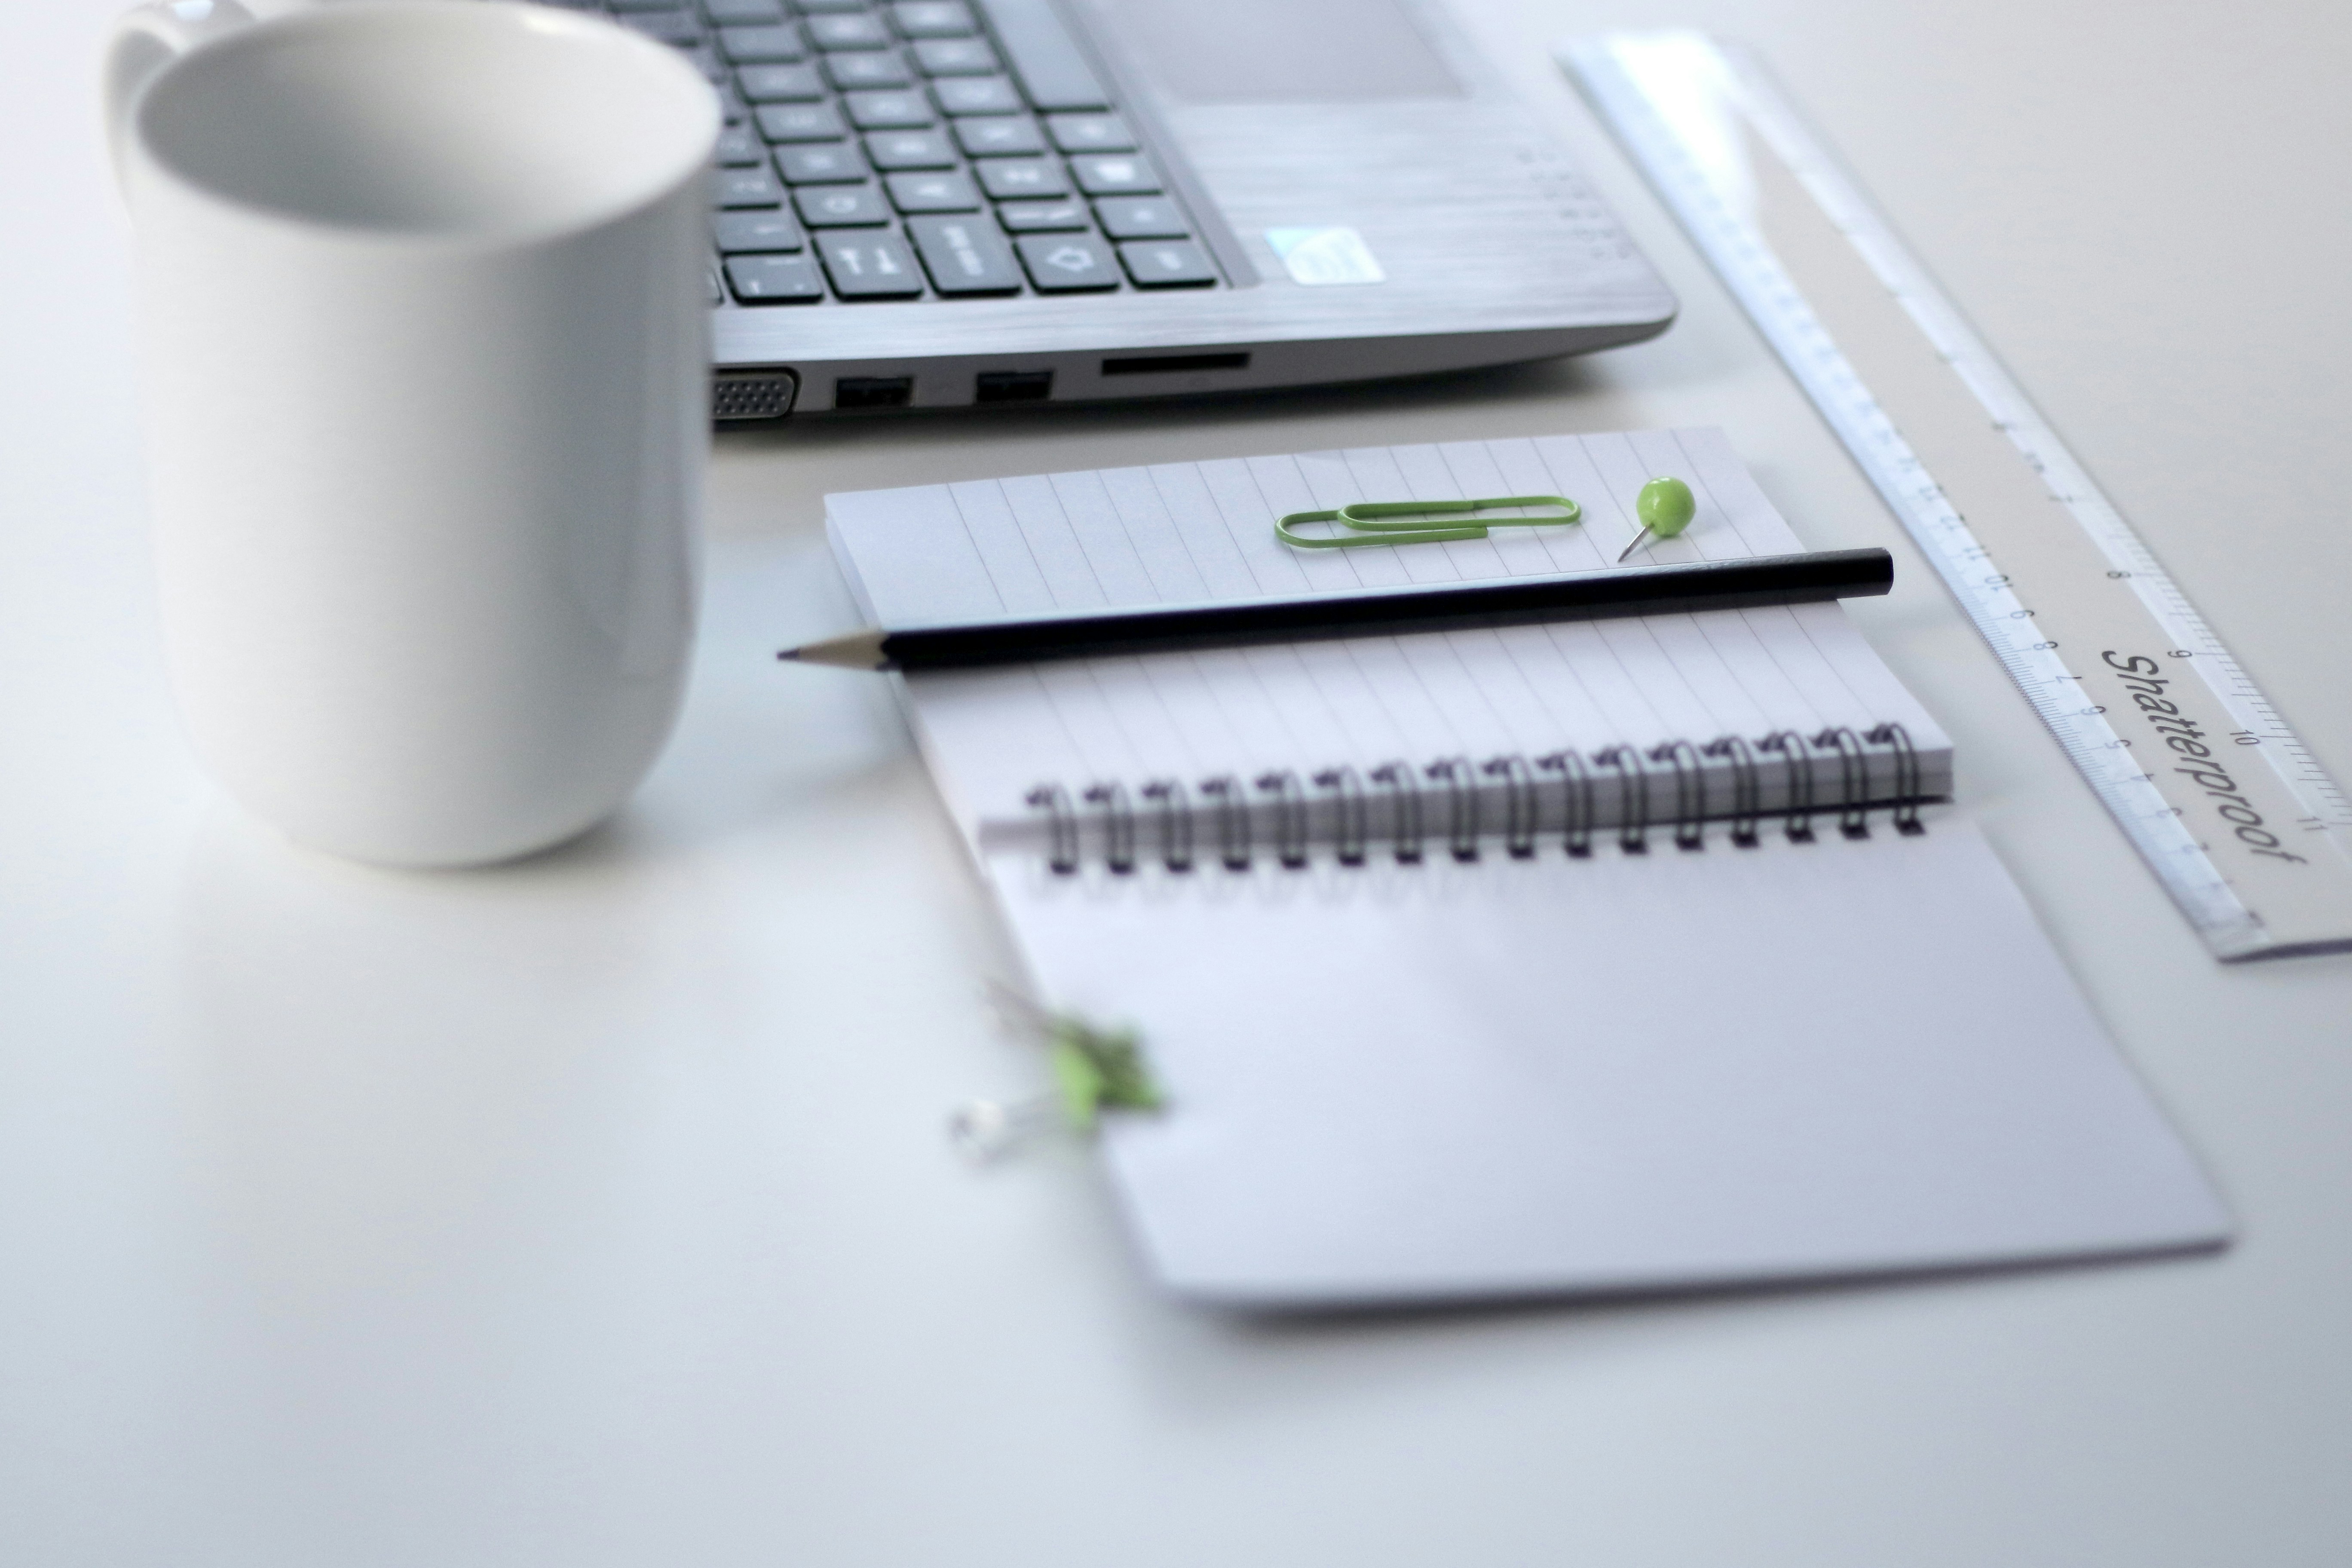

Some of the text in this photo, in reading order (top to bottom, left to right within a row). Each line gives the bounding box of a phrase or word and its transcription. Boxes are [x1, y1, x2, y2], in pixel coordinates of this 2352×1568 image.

[2107, 570, 2131, 579] 8
[1984, 575, 2013, 591] 10
[2010, 609, 2034, 619] 9
[2033, 641, 2058, 650] 8
[2055, 676, 2082, 684] 7
[2080, 706, 2106, 715] 6
[2230, 729, 2260, 744] 10
[2104, 739, 2131, 749] 5
[2101, 650, 2308, 864] Shatterproof
[2297, 817, 2328, 831] 11
